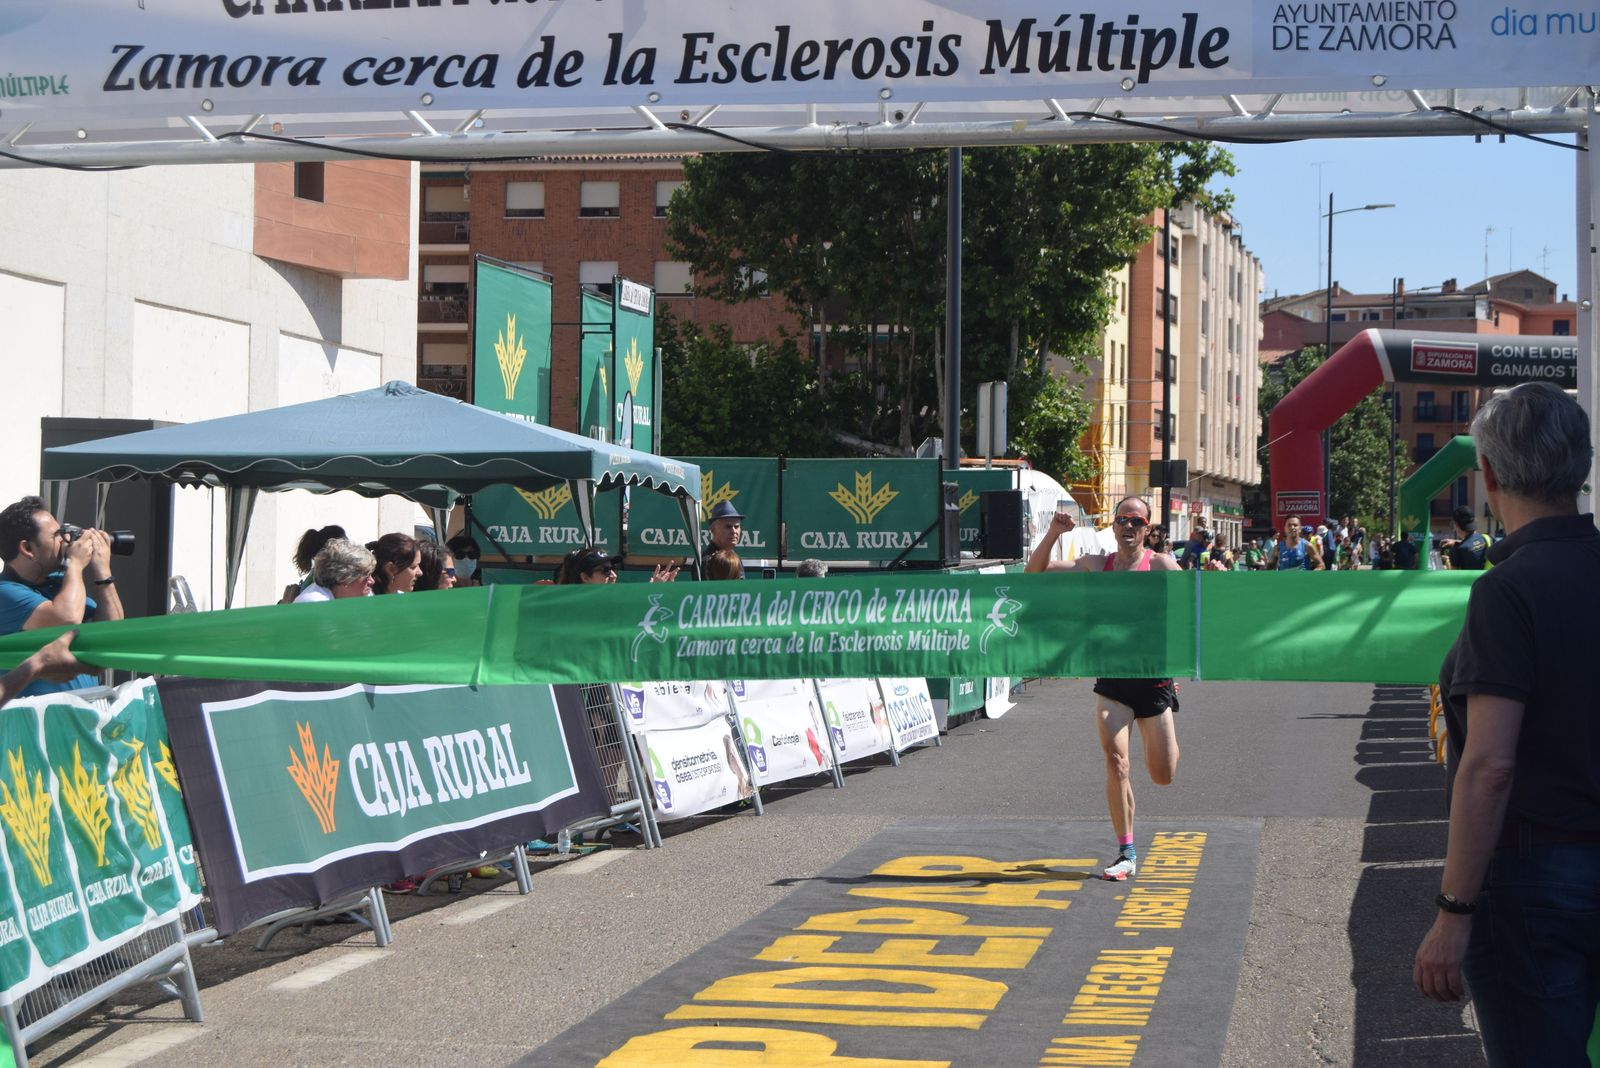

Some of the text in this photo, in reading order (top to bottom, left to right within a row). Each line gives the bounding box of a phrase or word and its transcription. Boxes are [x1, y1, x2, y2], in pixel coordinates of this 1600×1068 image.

[1272, 0, 1457, 23] AYUNTAMIENTO
[1491, 7, 1537, 36] dia
[1272, 23, 1457, 51] DE ZAMORA
[103, 12, 1231, 92] Zamora cerca de la Esclerosis Múltiple
[1427, 351, 1463, 359] DIPUTACIÓN
[1427, 358, 1473, 369] ZAMORA
[1491, 345, 1524, 359] CON
[1529, 346, 1547, 359] EL
[1491, 363, 1566, 378] GANAMOS
[487, 526, 533, 544] CAJA
[640, 528, 690, 546] CAJA
[800, 531, 928, 549] CAJA RURAL
[678, 587, 973, 629] CARRERA del CERCO de ZAMORA
[676, 628, 971, 658] Zamora cerca de la Esclerosis Múltiple
[348, 722, 533, 818] CAJA RURAL
[46, 891, 80, 922] RURAL
[1112, 886, 1193, 929] DISEÑO
[1061, 946, 1175, 1026] INTEGRAL
